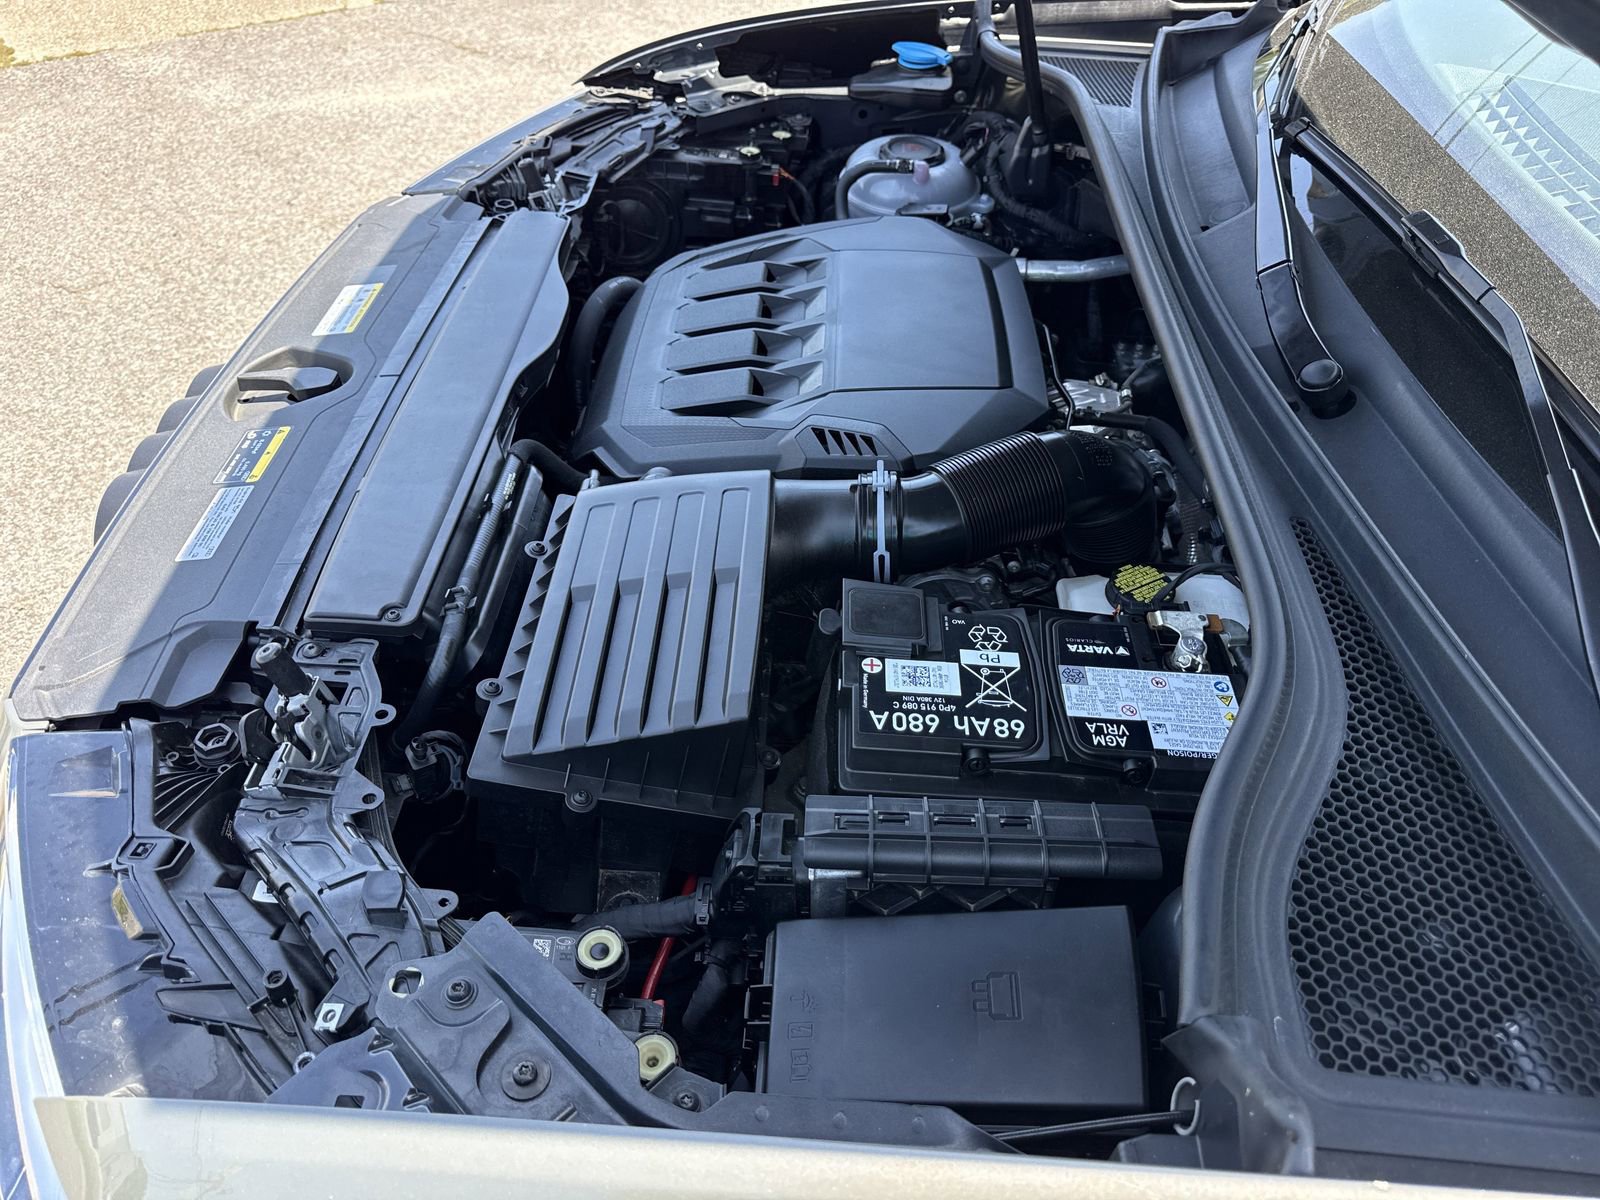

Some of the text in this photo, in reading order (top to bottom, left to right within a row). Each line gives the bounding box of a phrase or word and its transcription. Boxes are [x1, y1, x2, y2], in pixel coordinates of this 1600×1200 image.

[1066, 644, 1114, 654] VARTA
[979, 653, 1000, 663] Pb
[869, 710, 1025, 739] 68Ah 680A
[1085, 722, 1129, 736] VRLA
[1092, 734, 1127, 747] AGM
[1167, 749, 1217, 759] GER/POISON
